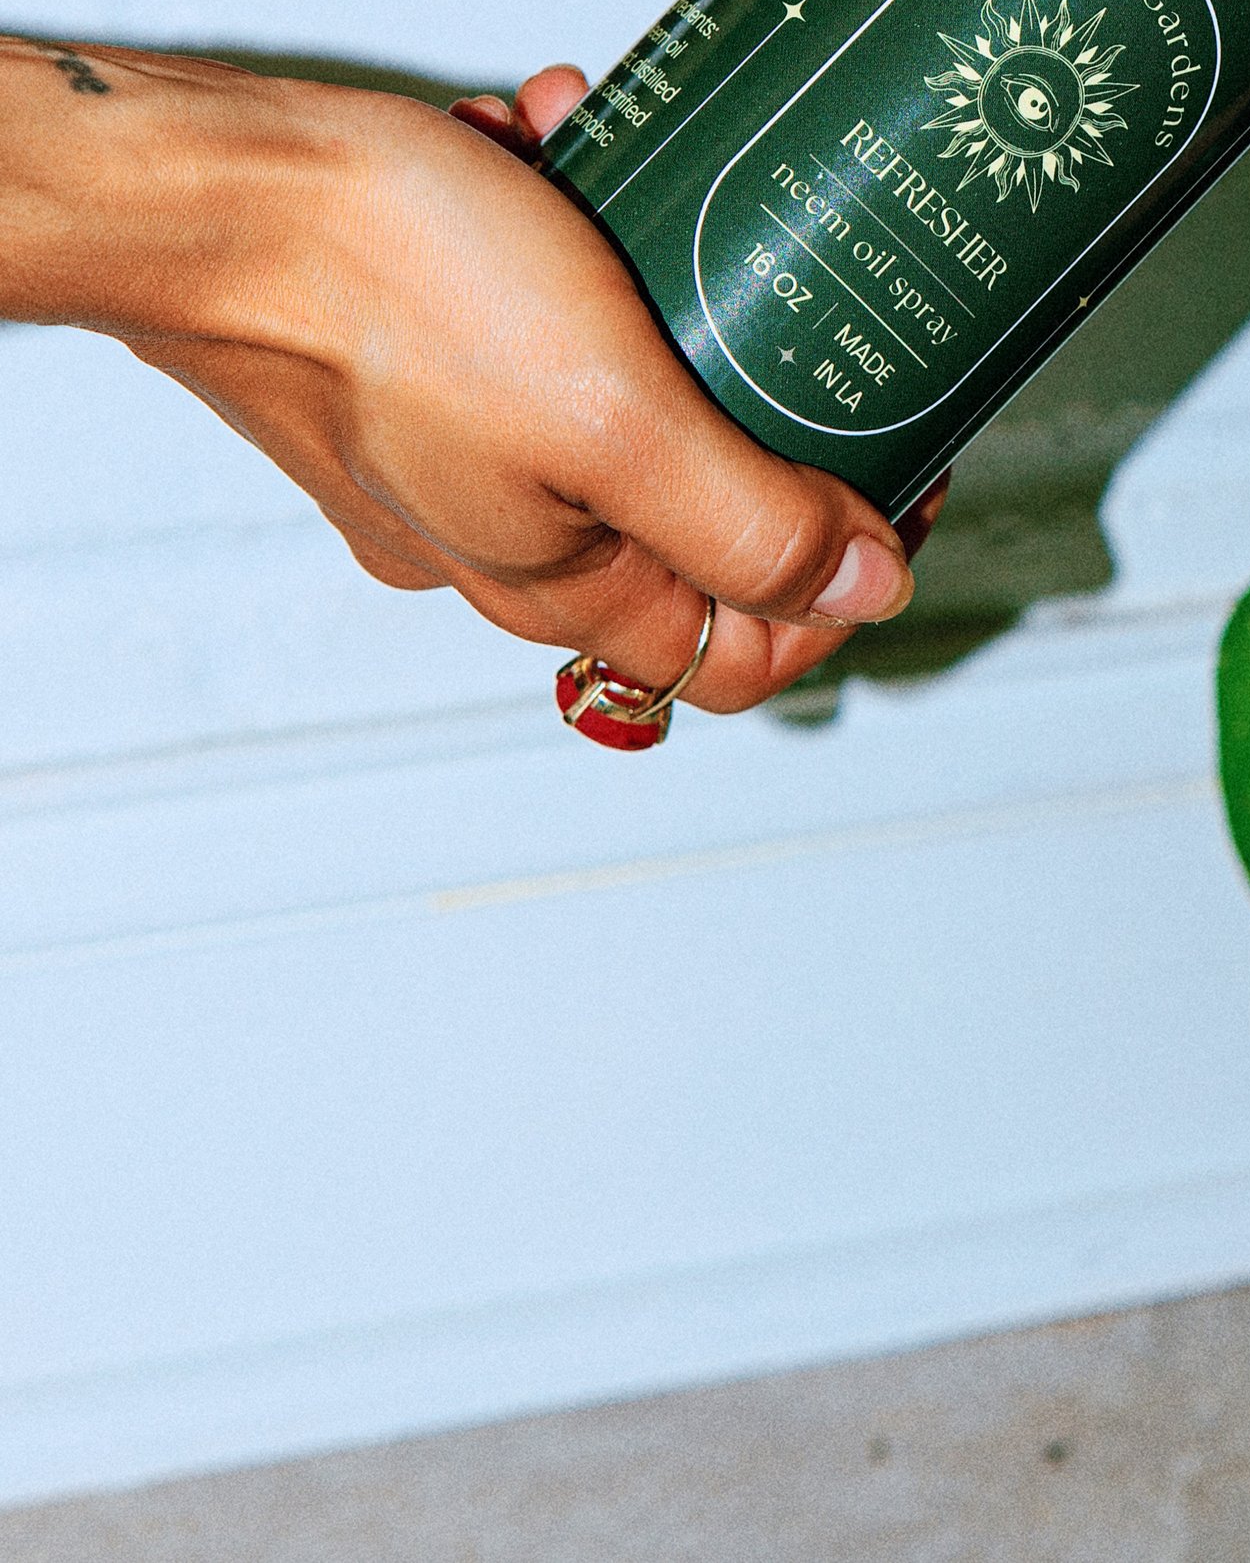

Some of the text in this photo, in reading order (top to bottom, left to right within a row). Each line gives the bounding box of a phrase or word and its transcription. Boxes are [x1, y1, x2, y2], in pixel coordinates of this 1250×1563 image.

[648, 23, 689, 60] eem oil
[602, 83, 653, 128] clarified
[631, 57, 682, 104] distilled
[839, 118, 1008, 291] REFRESHER
[743, 242, 814, 314] 16 OZ
[771, 162, 959, 345] neem oil spray
[833, 323, 896, 387] MADE
[812, 358, 863, 414] IN LA
